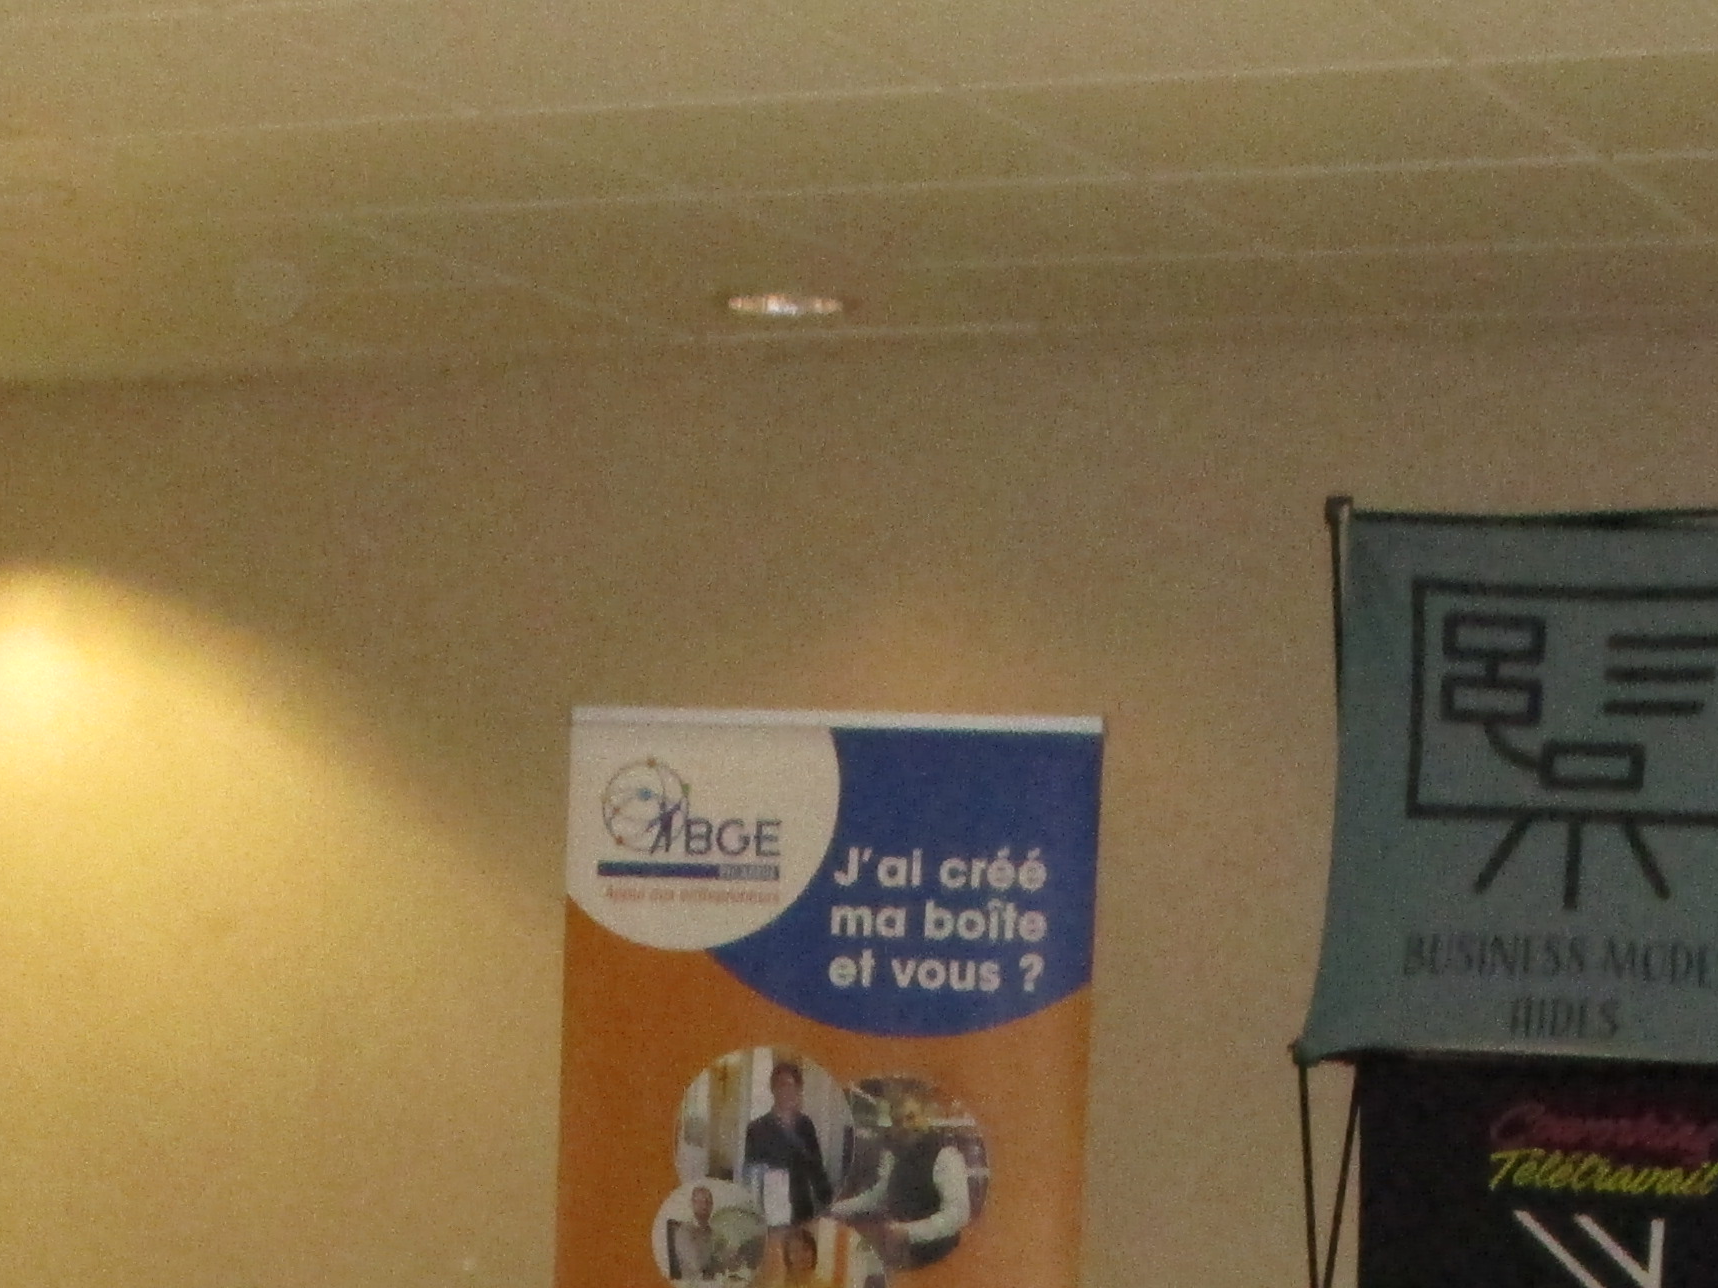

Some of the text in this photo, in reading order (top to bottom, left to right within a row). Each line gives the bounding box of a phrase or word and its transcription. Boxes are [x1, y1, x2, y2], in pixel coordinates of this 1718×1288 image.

[684, 817, 782, 857] BGE
[833, 846, 1048, 890] J'ai créé
[830, 899, 1048, 941] ma boîte
[828, 949, 1045, 992] et vous ?
[1404, 931, 1589, 979] BUSINESS
